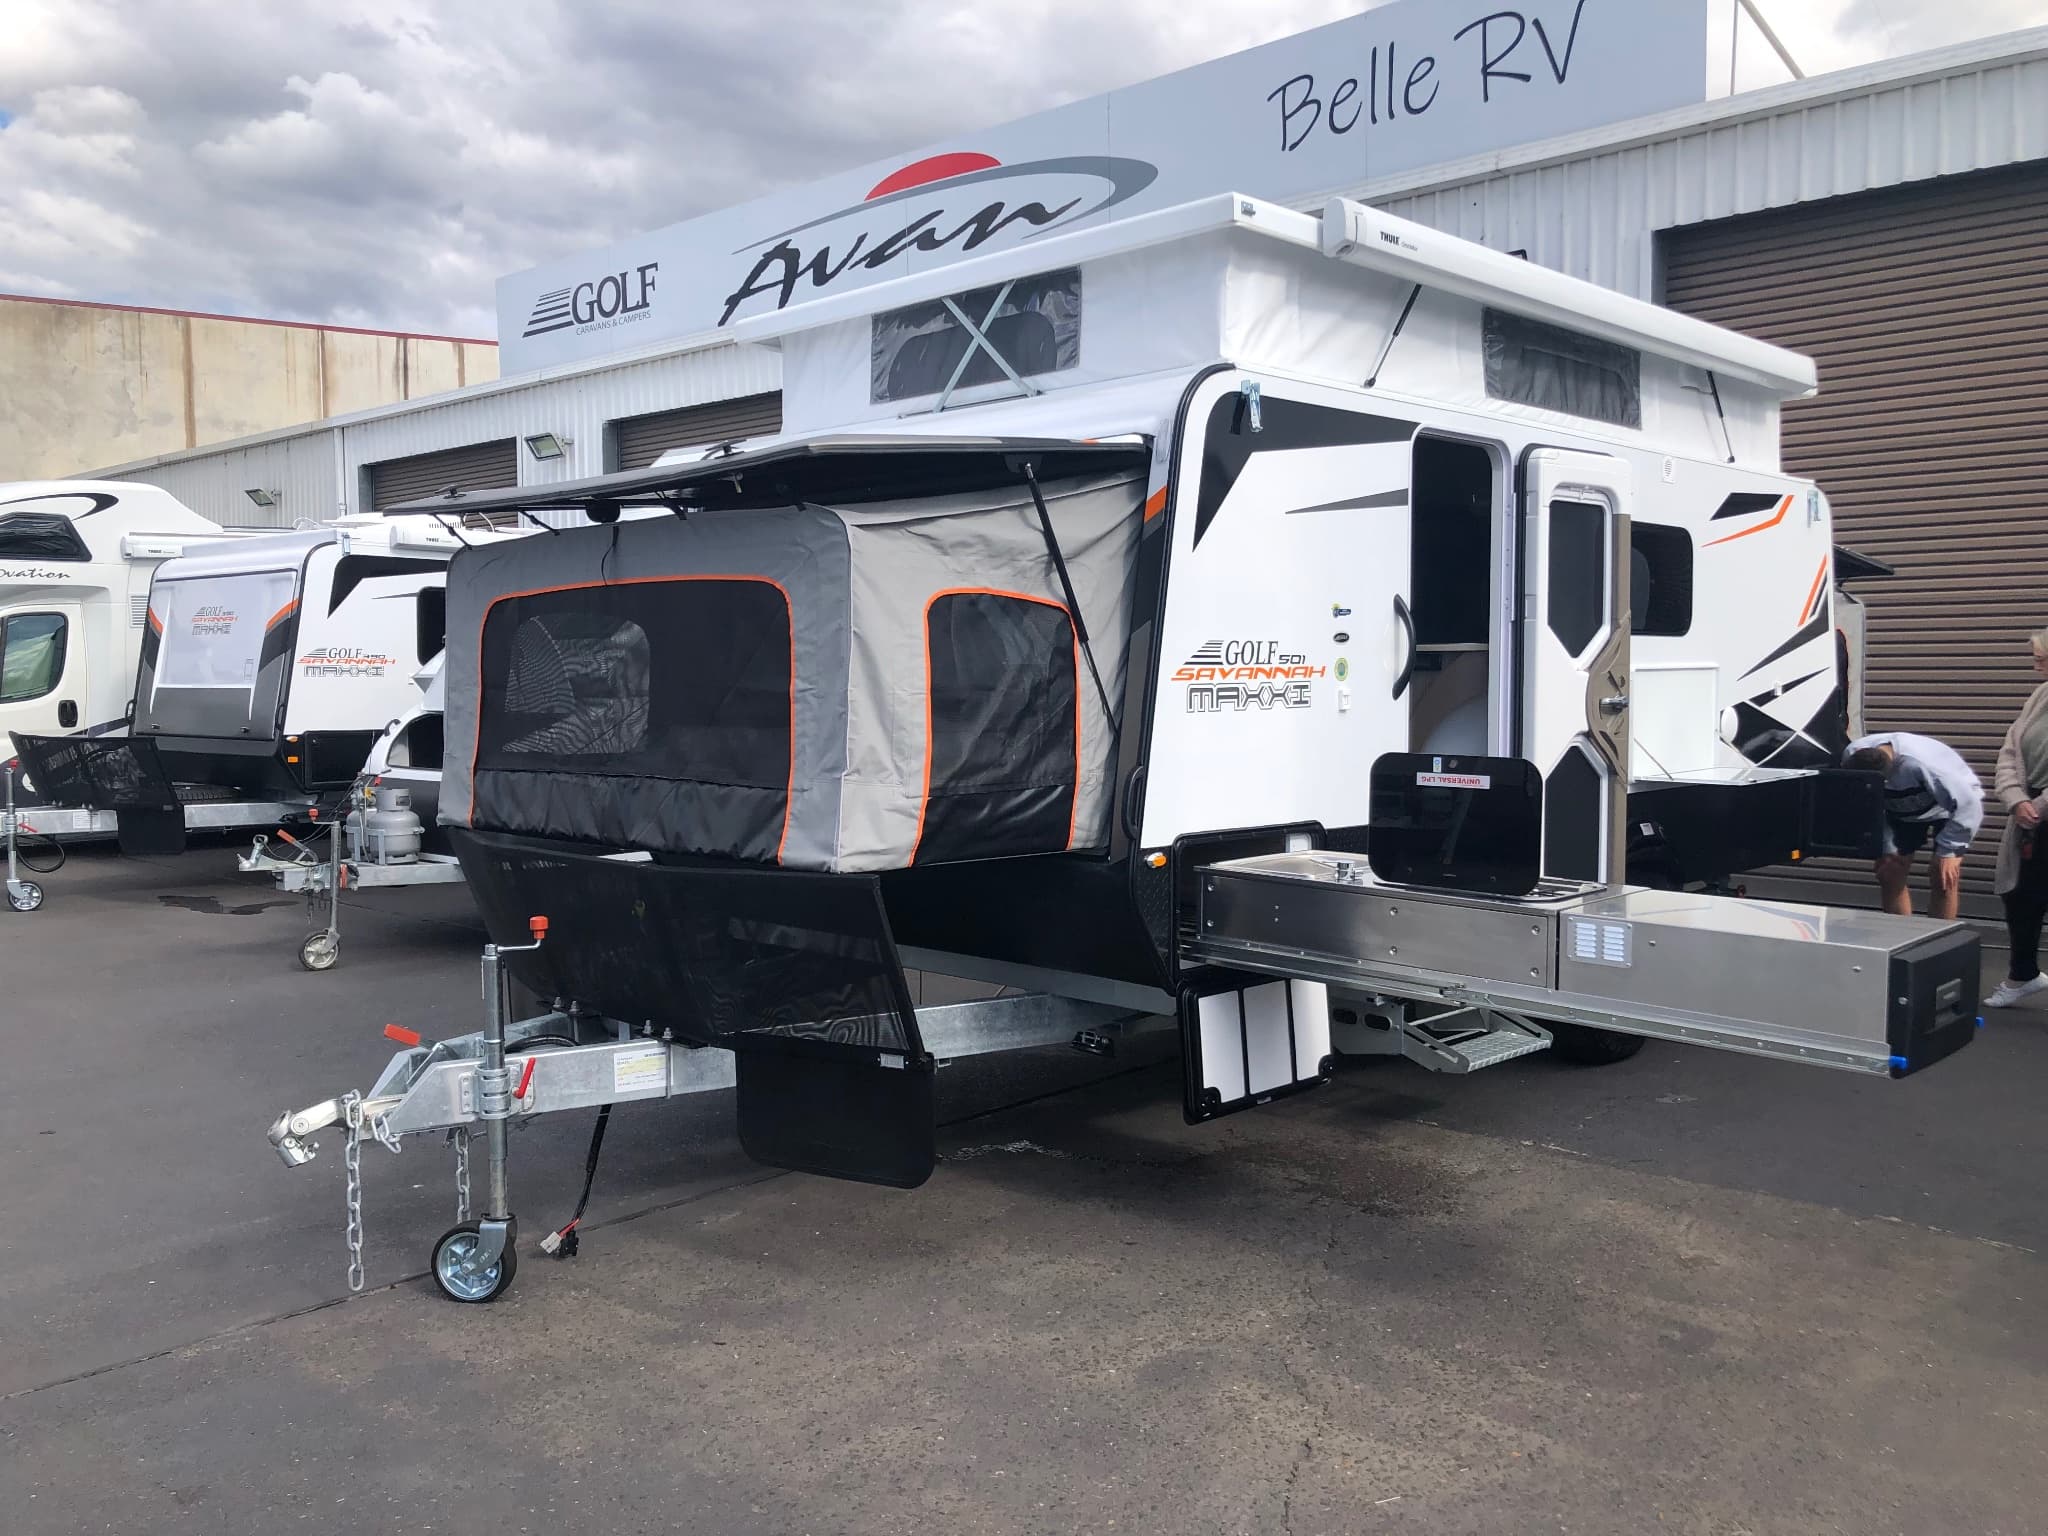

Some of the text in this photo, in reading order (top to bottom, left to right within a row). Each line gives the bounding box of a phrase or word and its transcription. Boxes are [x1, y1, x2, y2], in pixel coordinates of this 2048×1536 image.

[1266, 0, 1586, 151] Belle RV
[718, 197, 1082, 327] Avan
[571, 261, 659, 325] GOLF
[576, 319, 611, 336] CARAVANS
[618, 310, 651, 326] CAMPERS
[328, 648, 363, 659] GOLF
[1225, 640, 1306, 666] GOLF 501
[303, 665, 385, 677] MAXXI
[1171, 665, 1327, 682] SAVANNAH
[1186, 681, 1312, 713] MAXXI
[1421, 775, 1481, 785] UNIVERSAL LPG
